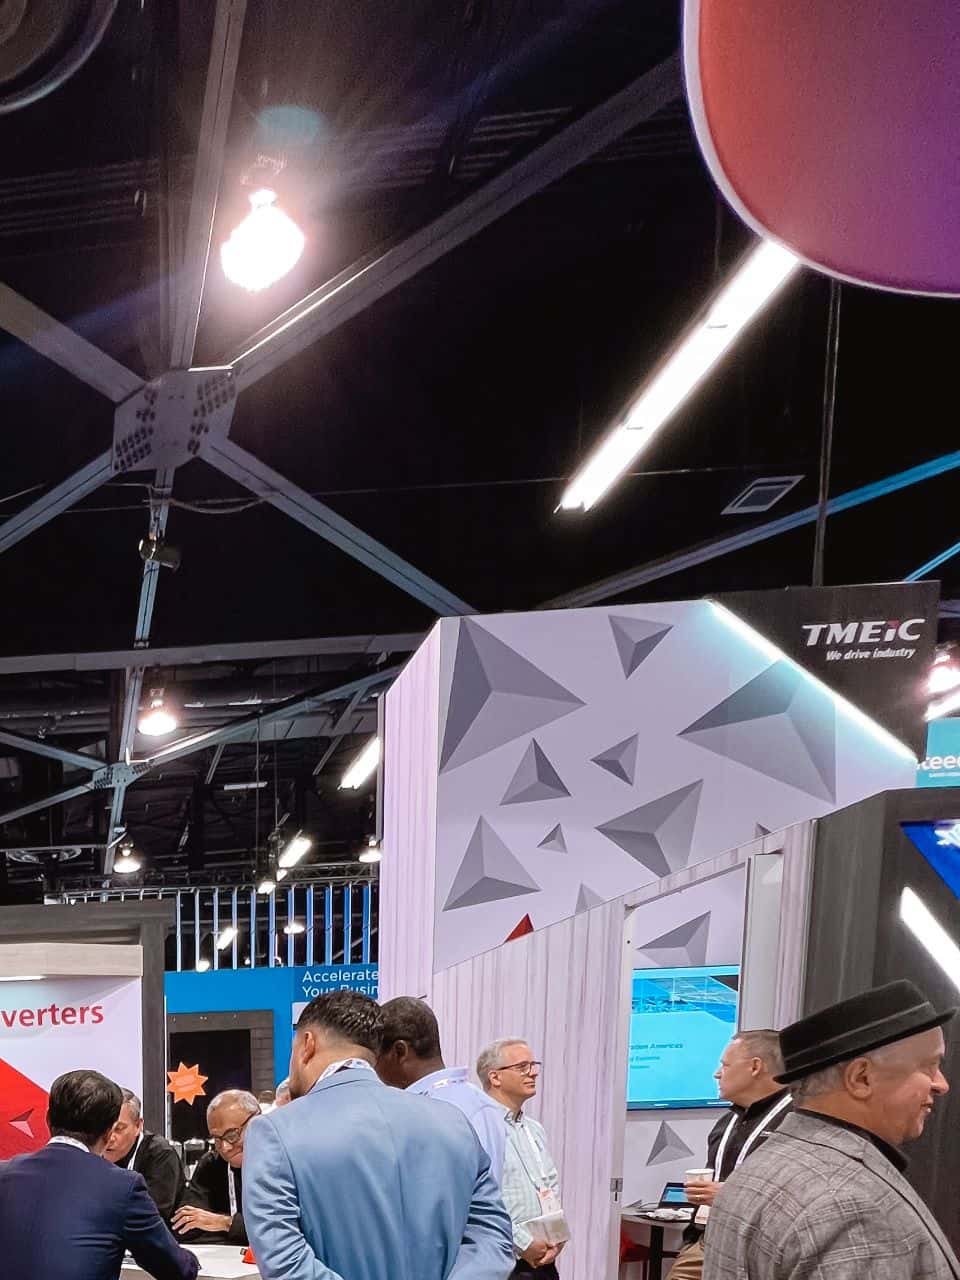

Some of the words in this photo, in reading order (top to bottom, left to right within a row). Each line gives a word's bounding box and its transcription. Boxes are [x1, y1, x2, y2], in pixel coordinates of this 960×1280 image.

[826, 650, 842, 661] We
[843, 648, 871, 660] drive
[873, 647, 916, 659] industry
[302, 969, 379, 983] Accelerate
